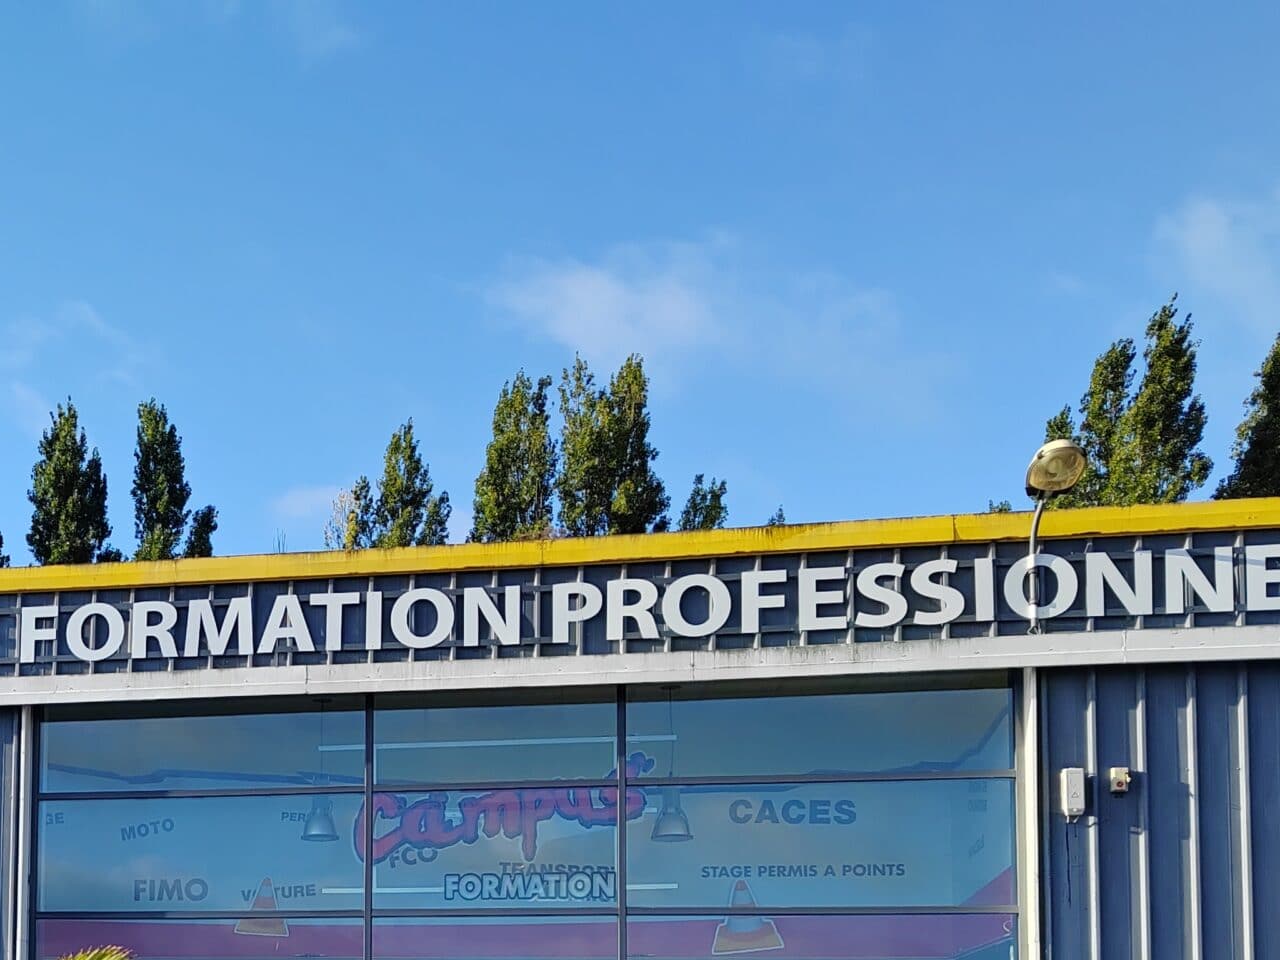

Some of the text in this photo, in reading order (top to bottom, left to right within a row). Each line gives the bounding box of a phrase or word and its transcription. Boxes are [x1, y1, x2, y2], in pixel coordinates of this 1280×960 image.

[19, 585, 520, 663] FORMATION
[552, 545, 1280, 644] PROFESSIONNE
[728, 798, 857, 825] CACES
[120, 818, 175, 841] MOTO
[701, 863, 905, 879] STAGE PERMIS A POINTS
[133, 878, 209, 902] FIMO
[443, 870, 617, 901] FORMATION
